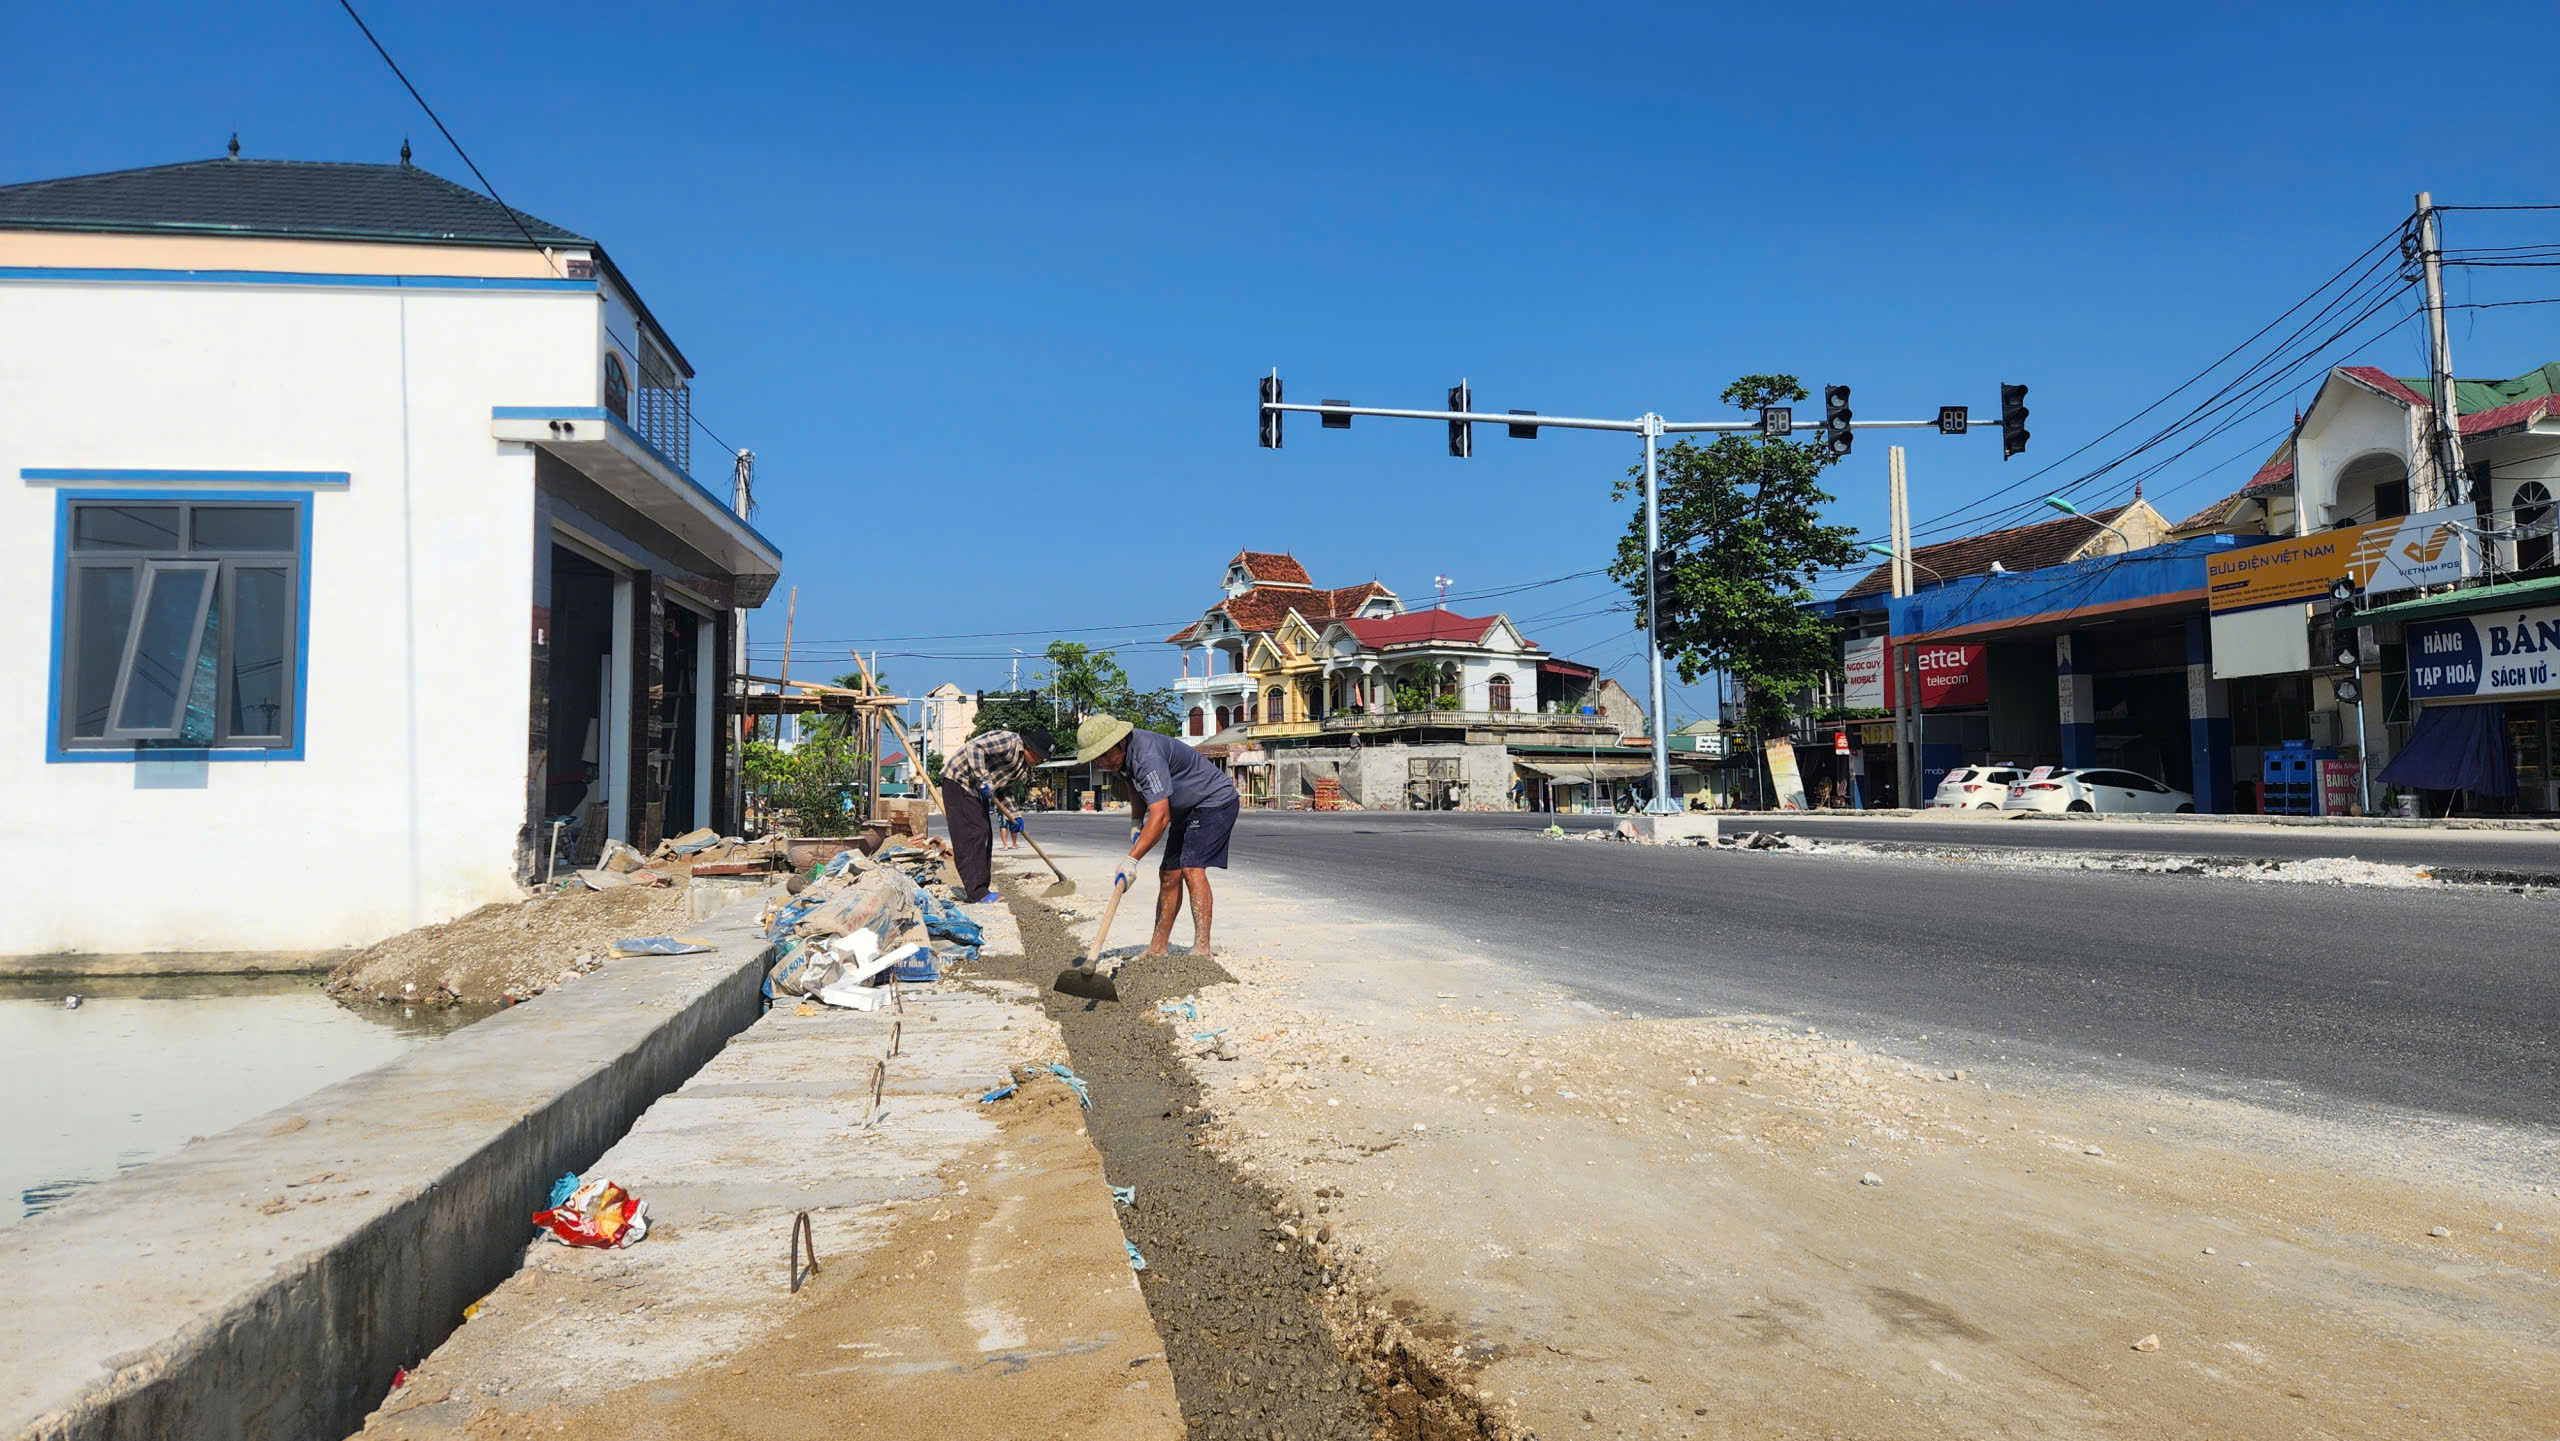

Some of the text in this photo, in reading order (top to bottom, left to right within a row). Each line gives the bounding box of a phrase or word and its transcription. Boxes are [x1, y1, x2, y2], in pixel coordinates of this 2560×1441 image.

[2209, 543, 2336, 577] BƯU ĐIỆN VIỆT NAM
[2398, 560, 2461, 577] VIETNAM POS
[2423, 630, 2463, 655] HÀNG
[2489, 614, 2560, 657] BÁN
[1846, 661, 1866, 673] NGỌC
[2415, 659, 2476, 690] TẠP HOÁ
[2491, 665, 2527, 688] SÁCH
[2529, 659, 2548, 685] VỞ
[1927, 674, 1969, 687] telecom
[1924, 767, 1945, 775] mobi
[2326, 771, 2349, 788] BÁNH
